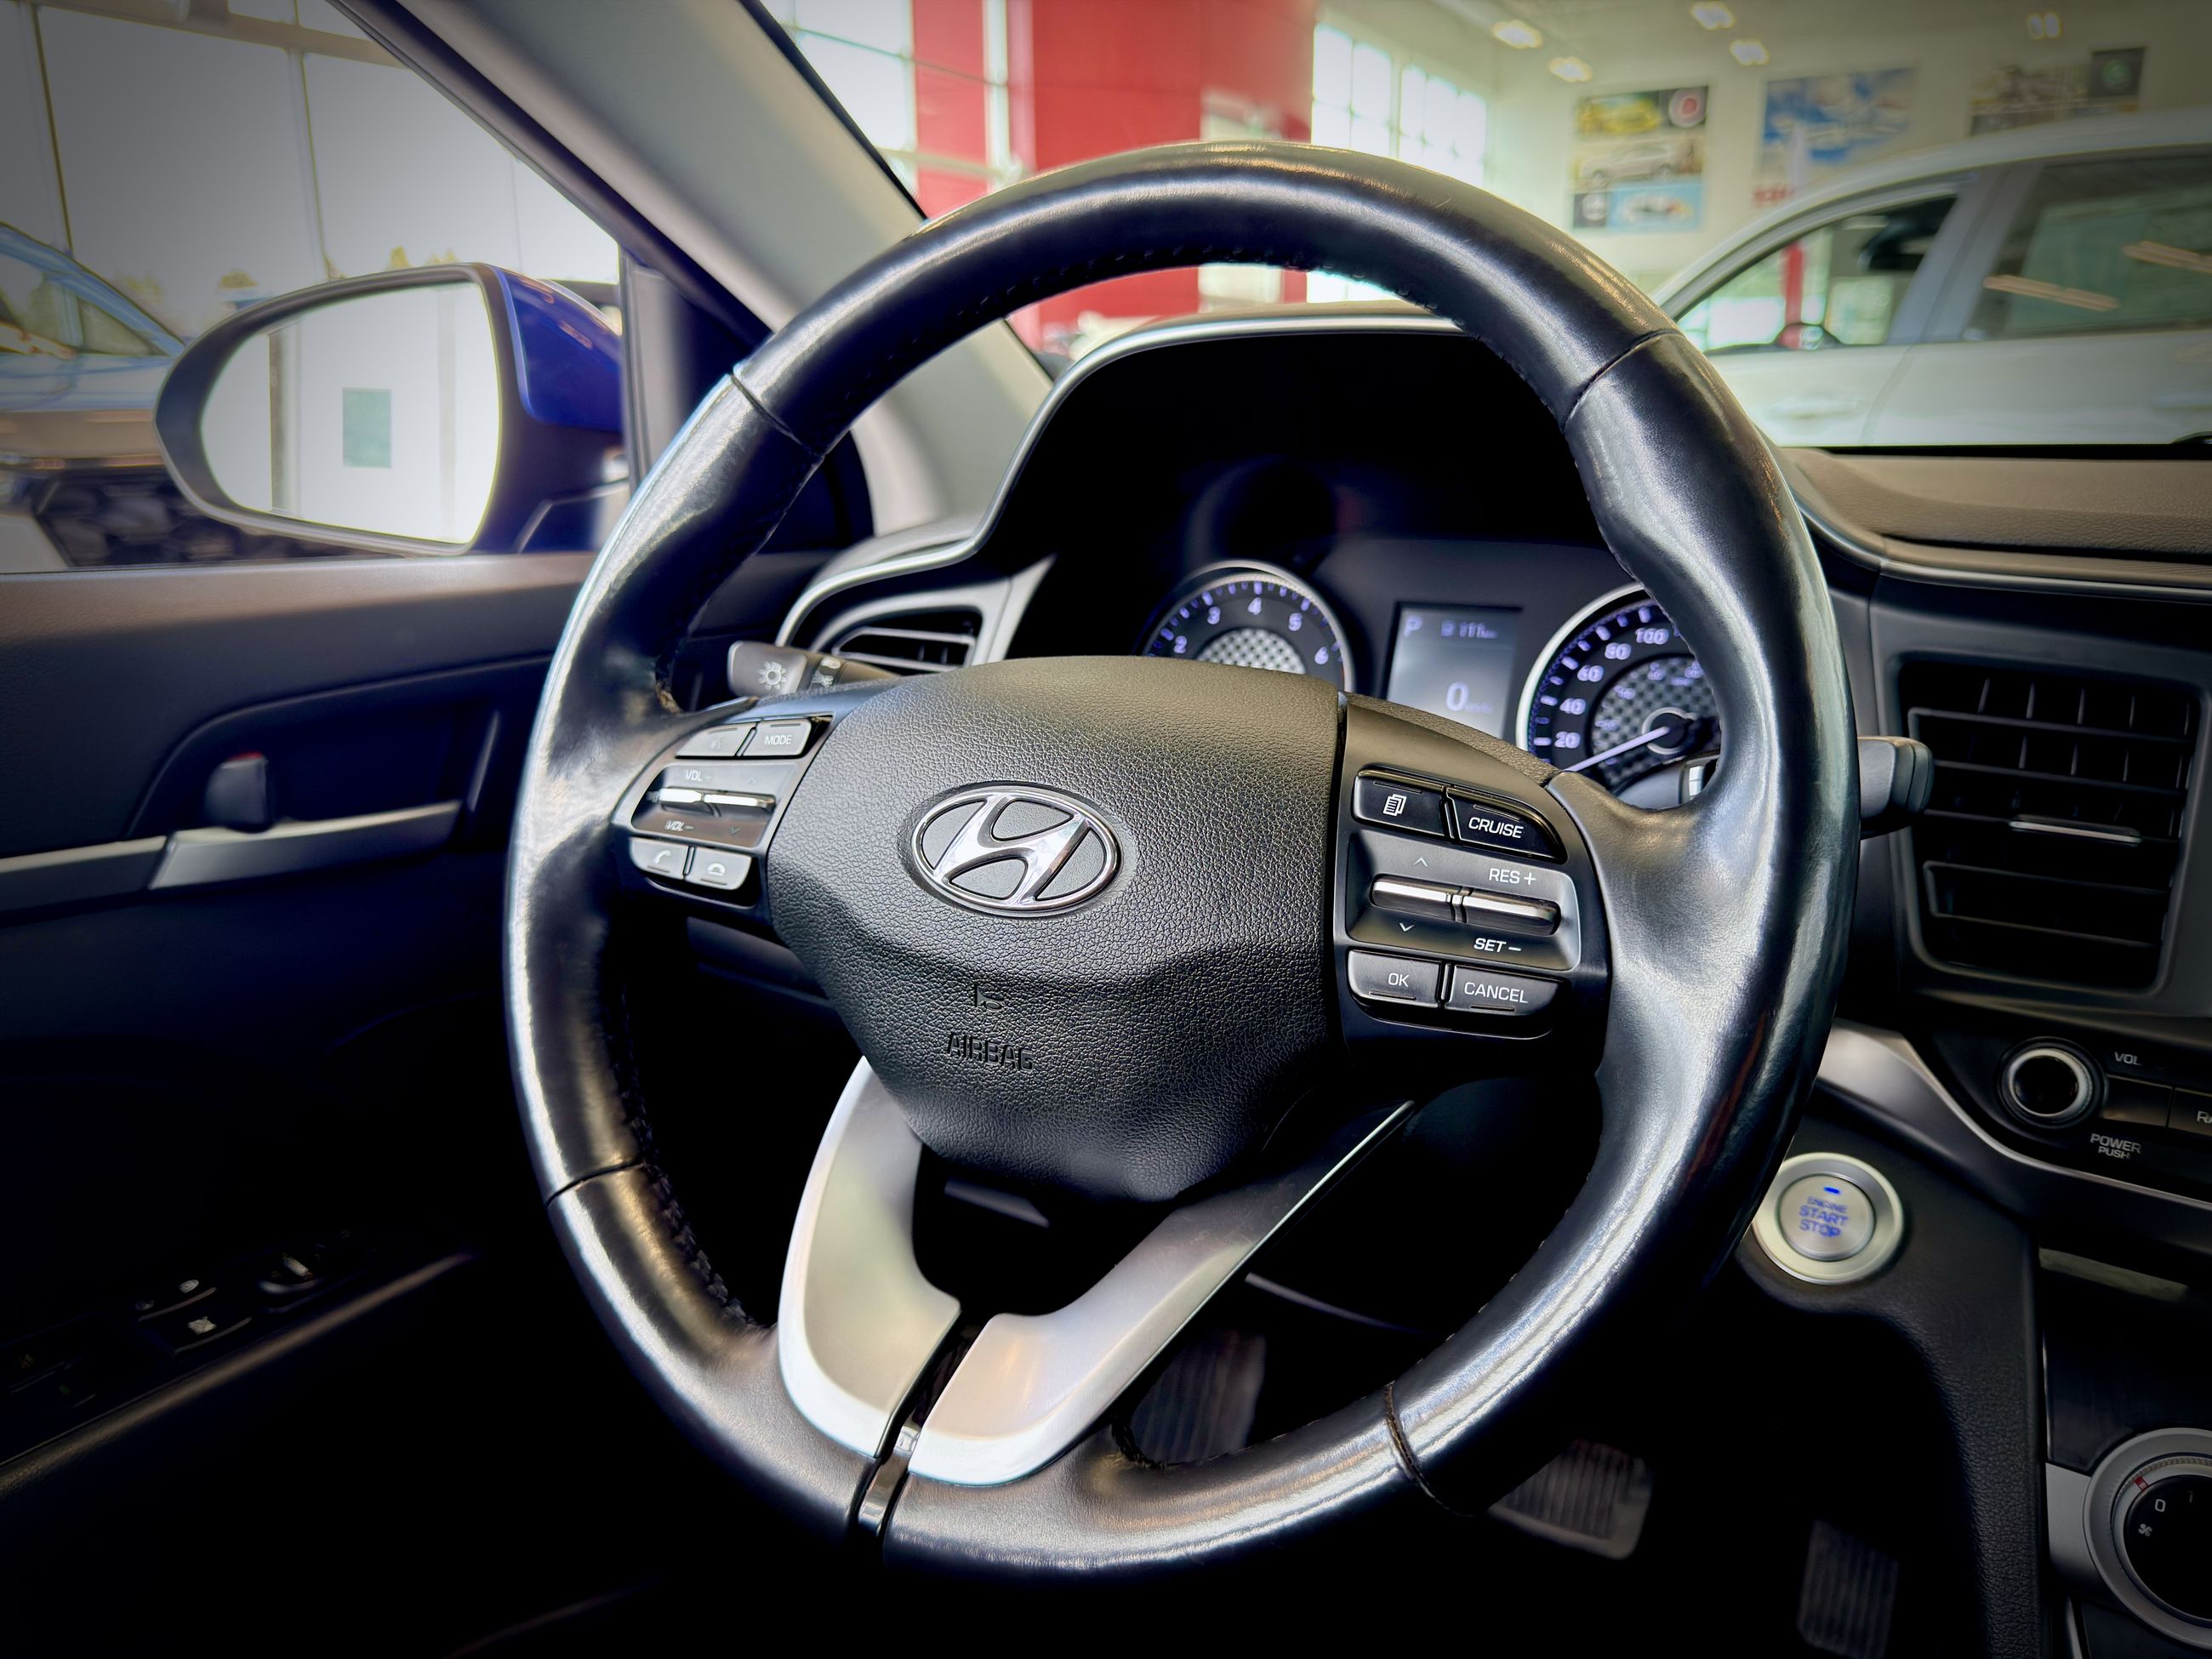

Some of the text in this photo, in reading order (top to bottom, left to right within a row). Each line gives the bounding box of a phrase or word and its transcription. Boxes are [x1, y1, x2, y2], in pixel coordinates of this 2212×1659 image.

[1247, 596, 1262, 615] 4
[1206, 605, 1221, 625] 3
[1288, 613, 1303, 632] 5
[1404, 615, 1422, 638] P
[1173, 635, 1188, 654] 2
[1634, 627, 1670, 646] 100
[1314, 646, 1329, 665] 6
[1605, 642, 1632, 660] 80
[1576, 664, 1604, 682] 60
[1446, 681, 1469, 711] 0
[1559, 698, 1586, 715] 40
[764, 734, 792, 745] MODE
[1554, 731, 1581, 749] 20
[686, 769, 703, 782] VOL
[665, 819, 684, 831] VOL
[1468, 817, 1524, 839] CRUISE
[1489, 868, 1520, 884] RES
[1474, 938, 1506, 953] SET
[1388, 972, 1410, 988] OK
[1463, 982, 1528, 1004] CANCEL
[947, 1032, 1035, 1074] AIRBAG
[2114, 1052, 2141, 1066] VOL
[2089, 1133, 2141, 1154] POWER
[2098, 1146, 2130, 1160] PUSH
[1799, 1205, 1849, 1226] START
[1799, 1219, 1841, 1236] STOP
[2154, 1498, 2166, 1513] 0
